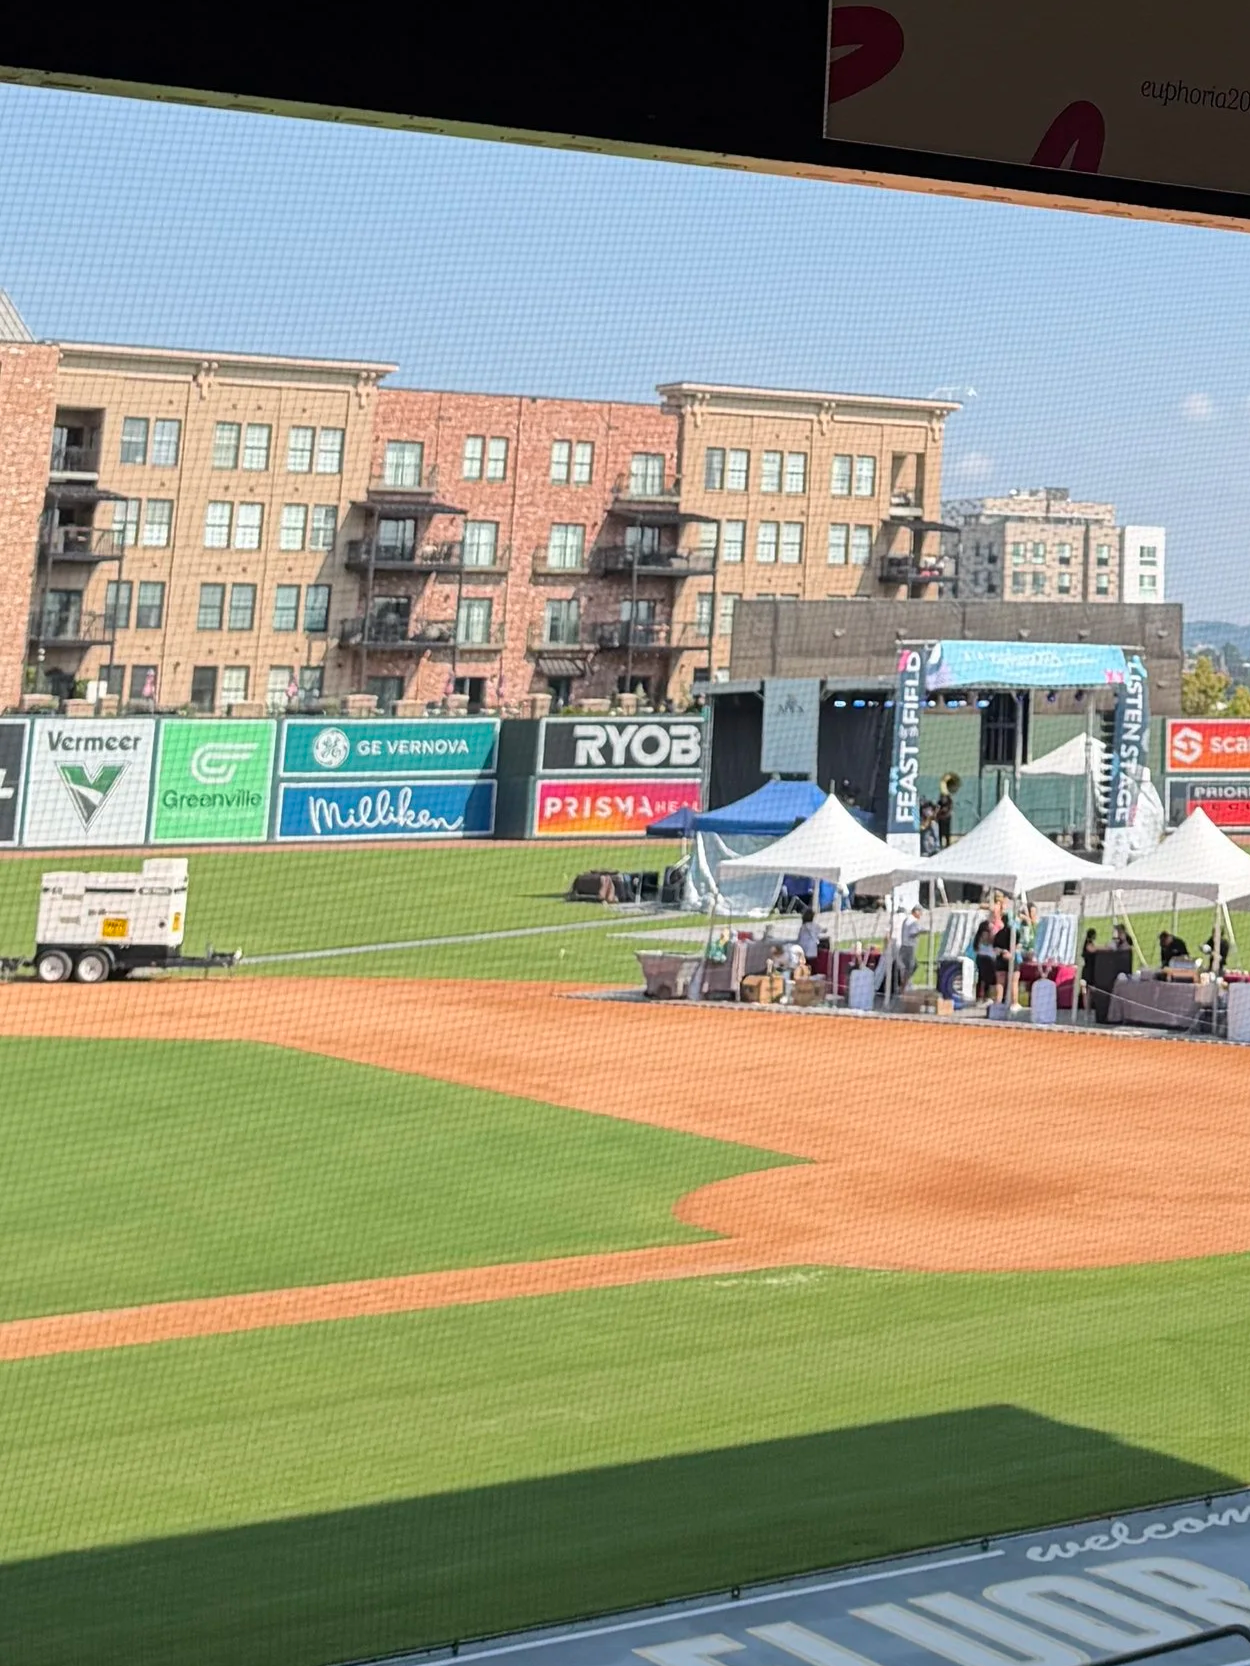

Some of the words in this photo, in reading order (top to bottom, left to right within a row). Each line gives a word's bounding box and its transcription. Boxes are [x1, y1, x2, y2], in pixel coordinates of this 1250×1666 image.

[902, 652, 922, 724] FIELD
[1121, 661, 1146, 741] LISTEN
[47, 731, 143, 752] Vermeer
[356, 740, 383, 756] GE
[387, 739, 470, 756] VERNOVA
[572, 724, 702, 766] RYOB
[162, 789, 263, 810] Greenville
[895, 741, 920, 823] FEAST
[308, 786, 465, 835] Milliken
[544, 795, 655, 819] PRISMA
